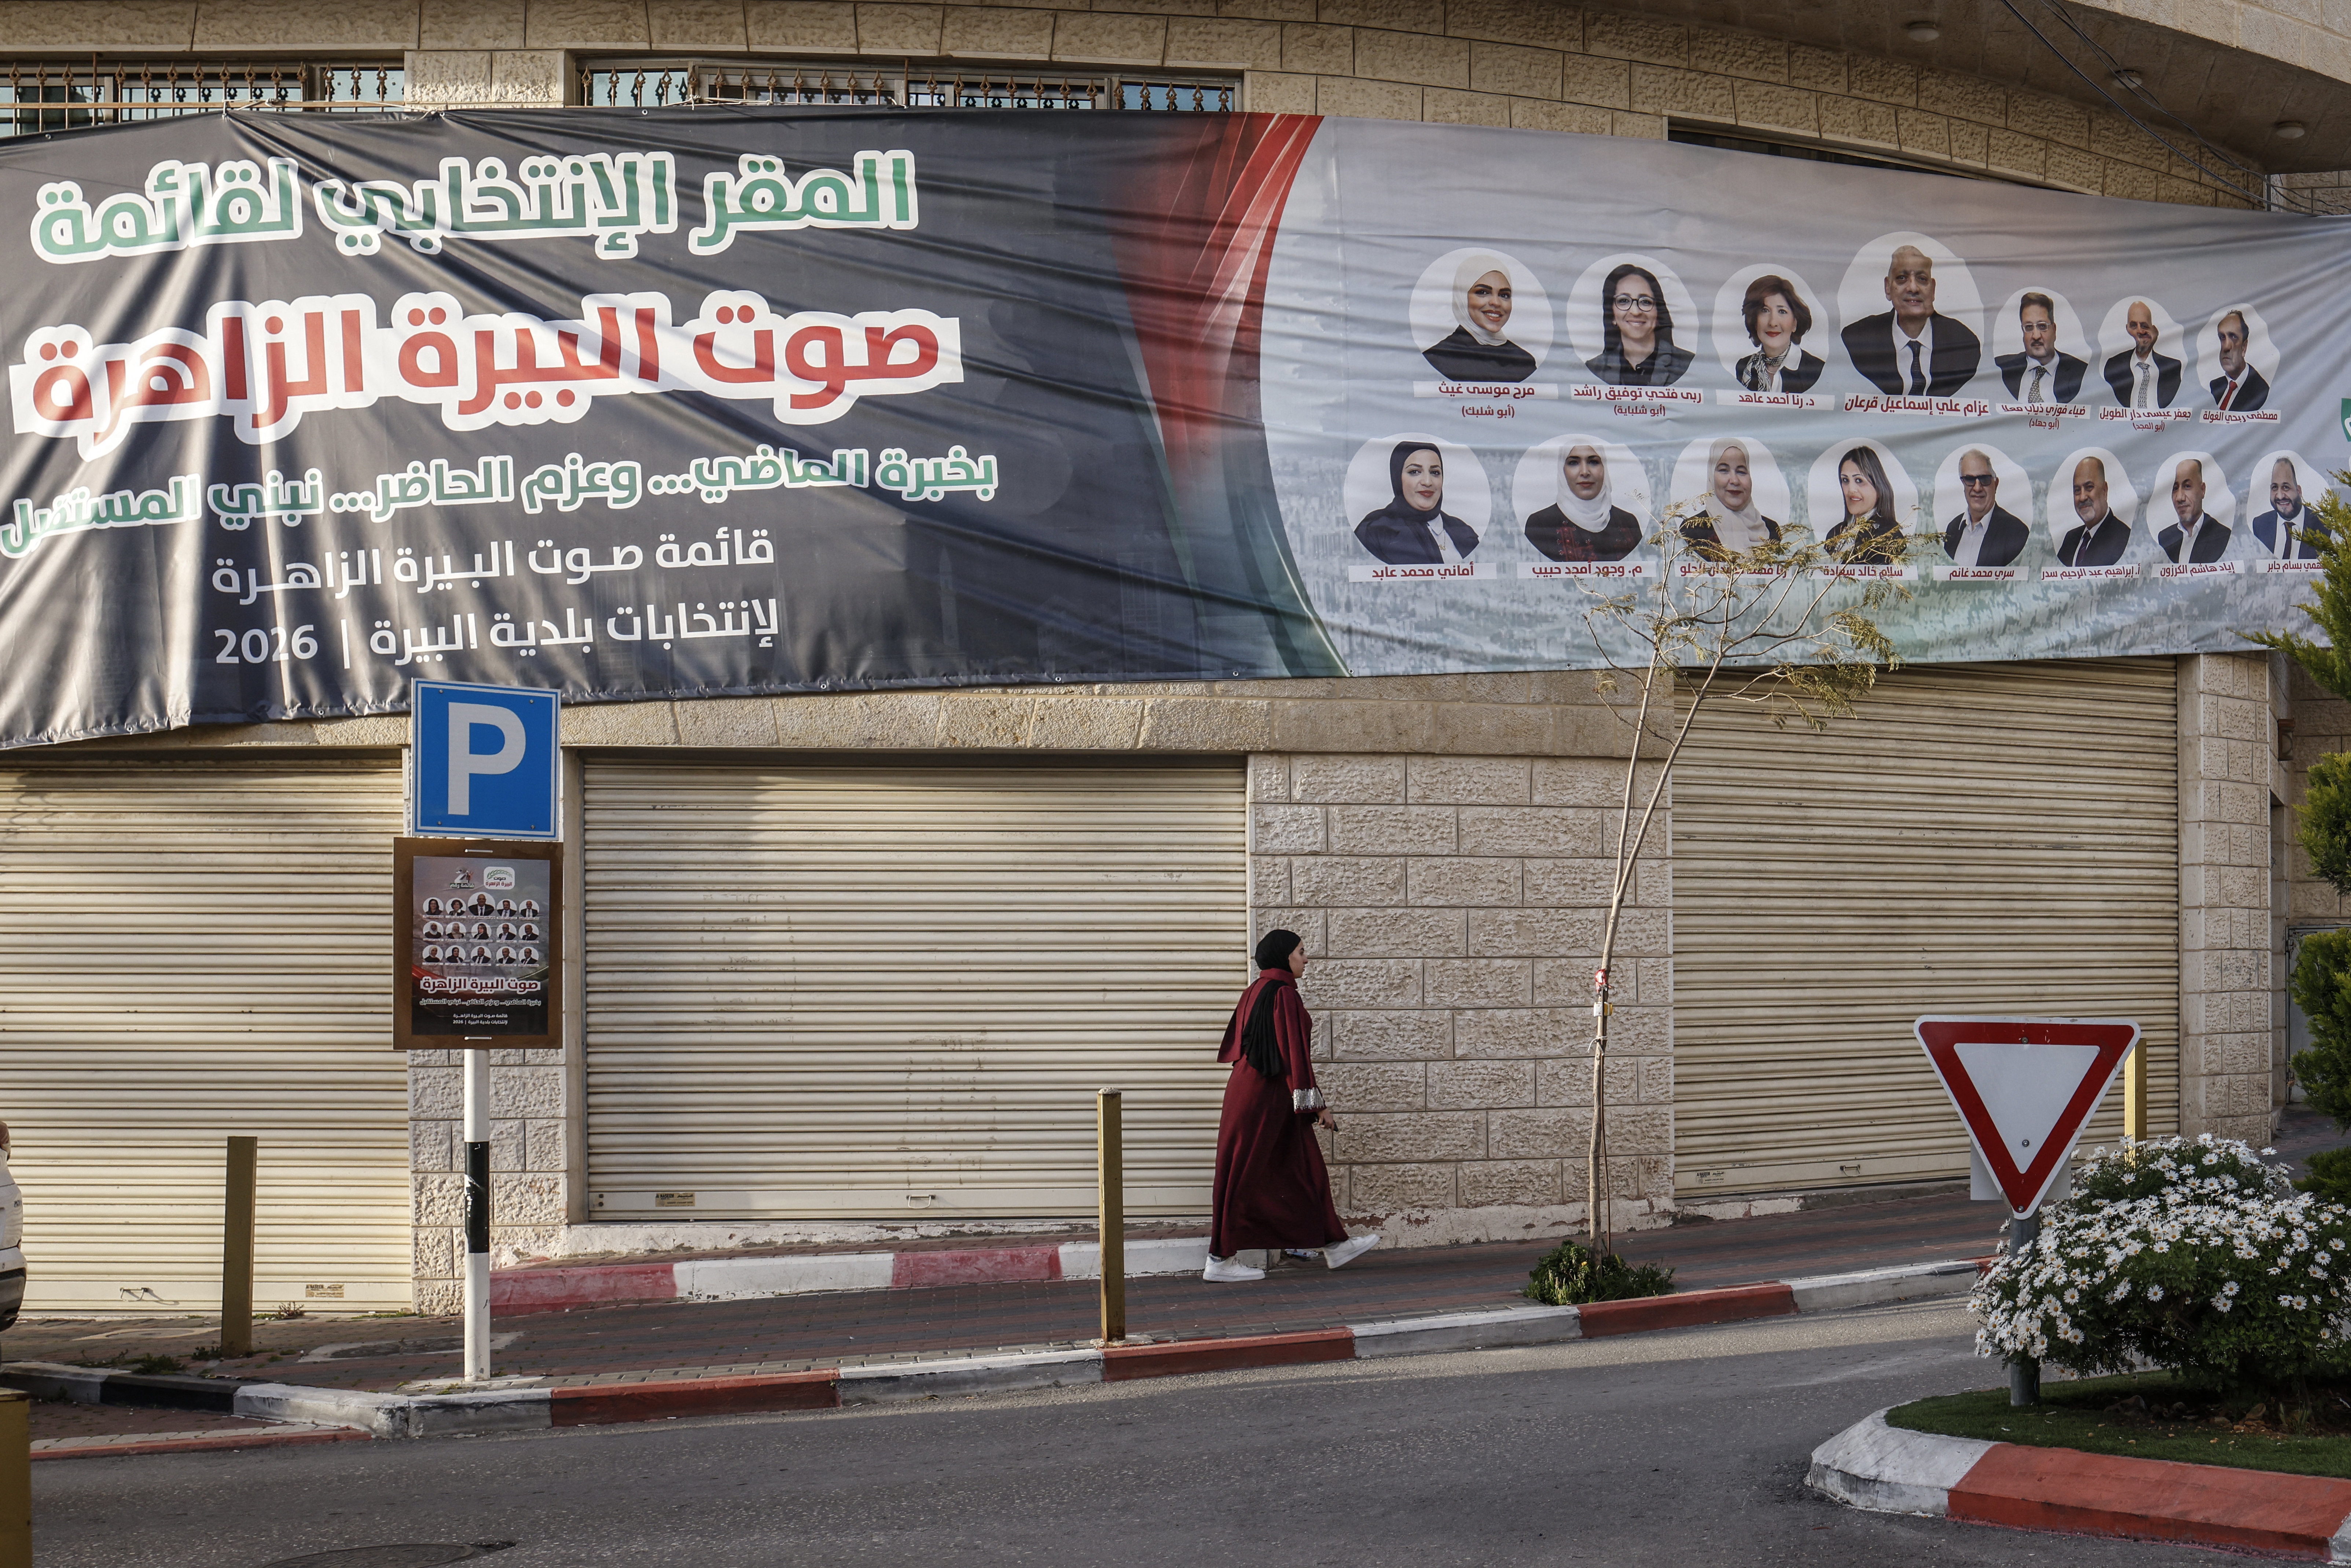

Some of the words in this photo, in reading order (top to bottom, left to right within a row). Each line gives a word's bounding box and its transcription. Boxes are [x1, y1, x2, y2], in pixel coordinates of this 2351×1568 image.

[313, 152, 677, 260] الإنتخابي
[689, 150, 918, 255] المقر
[30, 157, 303, 264] لقائمة
[398, 306, 659, 415] البيرة
[693, 305, 939, 409] صوت
[33, 309, 364, 446] الزاهرة
[1439, 381, 1463, 397] غيث
[1466, 386, 1510, 397] موسى
[1513, 386, 1535, 399] مرح
[1574, 384, 1601, 400] راشد
[1605, 387, 1642, 401] توفيق
[1646, 388, 1678, 401] فتحي
[1681, 391, 1702, 403] ربى
[1739, 393, 1764, 403] عاهد
[1767, 391, 1789, 404] أحمد
[1793, 394, 1803, 408] رنا
[1806, 398, 1815, 406] د.
[1844, 395, 1878, 412] قرعان
[1881, 397, 1933, 415] إسماعيل
[1936, 399, 1961, 415] علي
[1964, 400, 1990, 416] عزام
[2024, 404, 2043, 415] ذياب
[2046, 404, 2067, 416] فوزي
[2068, 405, 2086, 418] ضياء
[2100, 407, 2127, 421] الطويل
[2130, 409, 2142, 421] دار
[2142, 411, 2172, 419] عيسى
[2174, 409, 2191, 421] جعفر
[2203, 411, 2224, 423] الغولة
[2225, 415, 2247, 424] ربحي
[2247, 411, 2278, 420] مصطفى
[876, 445, 998, 501] بخبرة
[521, 452, 641, 514] وعزم
[207, 468, 324, 531] نبني
[0, 474, 201, 558] المستقبل
[656, 527, 774, 568] قائمة
[393, 540, 514, 594] البيرة
[528, 539, 643, 584] صوت
[2219, 562, 2236, 574] إياد
[2267, 560, 2281, 573] جابر
[2282, 560, 2302, 573] بسام
[2304, 563, 2323, 572] همي
[1372, 566, 1397, 580] عابد
[1401, 569, 1434, 577] محمد
[1437, 561, 1473, 579] أماني
[1532, 566, 1561, 578] حبيب
[1628, 566, 1642, 577] م.
[1858, 566, 1877, 576] خالد
[1879, 566, 1903, 579] سلام
[1949, 568, 1969, 581] غانم
[1995, 570, 2014, 580] سري
[2041, 571, 2058, 580] سدر
[2060, 568, 2086, 580] الرحيم
[2089, 569, 2103, 578] عبد
[2105, 566, 2134, 578] إبراهيم
[2160, 564, 2187, 577] الكرزون
[2190, 562, 2217, 577] هاشم
[213, 549, 381, 605] الزاهرة
[607, 599, 778, 649] لإنتخابات
[490, 608, 594, 656] بلدية
[215, 625, 318, 664] 2026
[370, 613, 477, 665] البيرة
[448, 702, 526, 815] P
[423, 978, 466, 992] الزاهرة
[470, 978, 504, 992] البيرة
[507, 979, 538, 992] صوت
